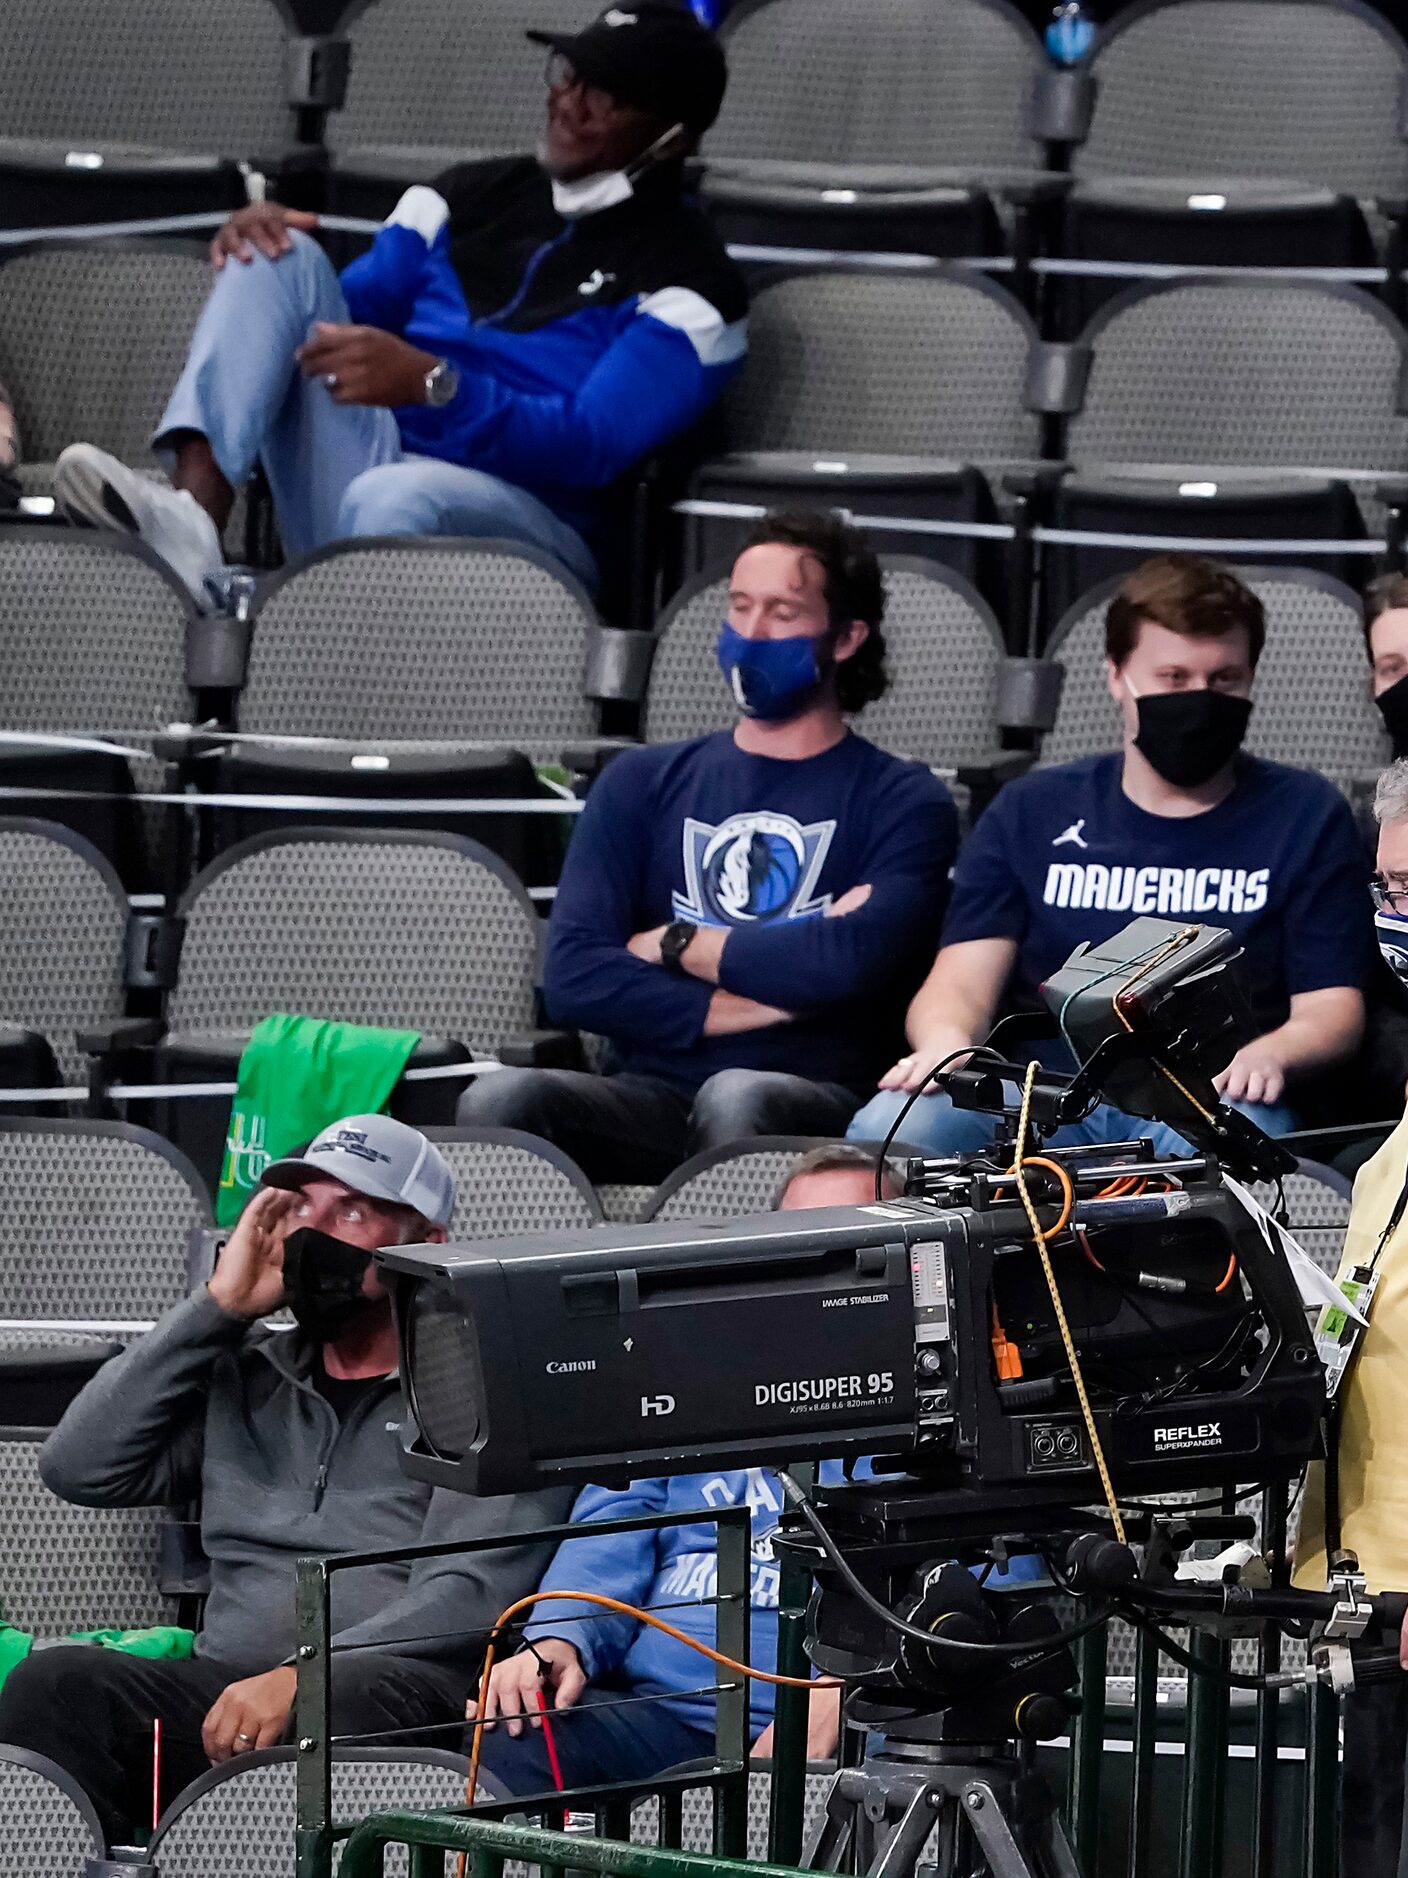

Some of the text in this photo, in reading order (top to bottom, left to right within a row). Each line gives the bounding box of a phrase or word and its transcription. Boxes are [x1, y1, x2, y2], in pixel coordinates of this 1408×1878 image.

[1043, 863, 1271, 914] MAVERICKS
[822, 1293, 889, 1308] IMAGE STABILIZER
[546, 1359, 596, 1374] Canon
[755, 1372, 894, 1406] DIGISUPER 95
[641, 1394, 676, 1417] HD
[1154, 1422, 1221, 1443] REFLEX
[1155, 1438, 1222, 1452] SUPERXPANDER
